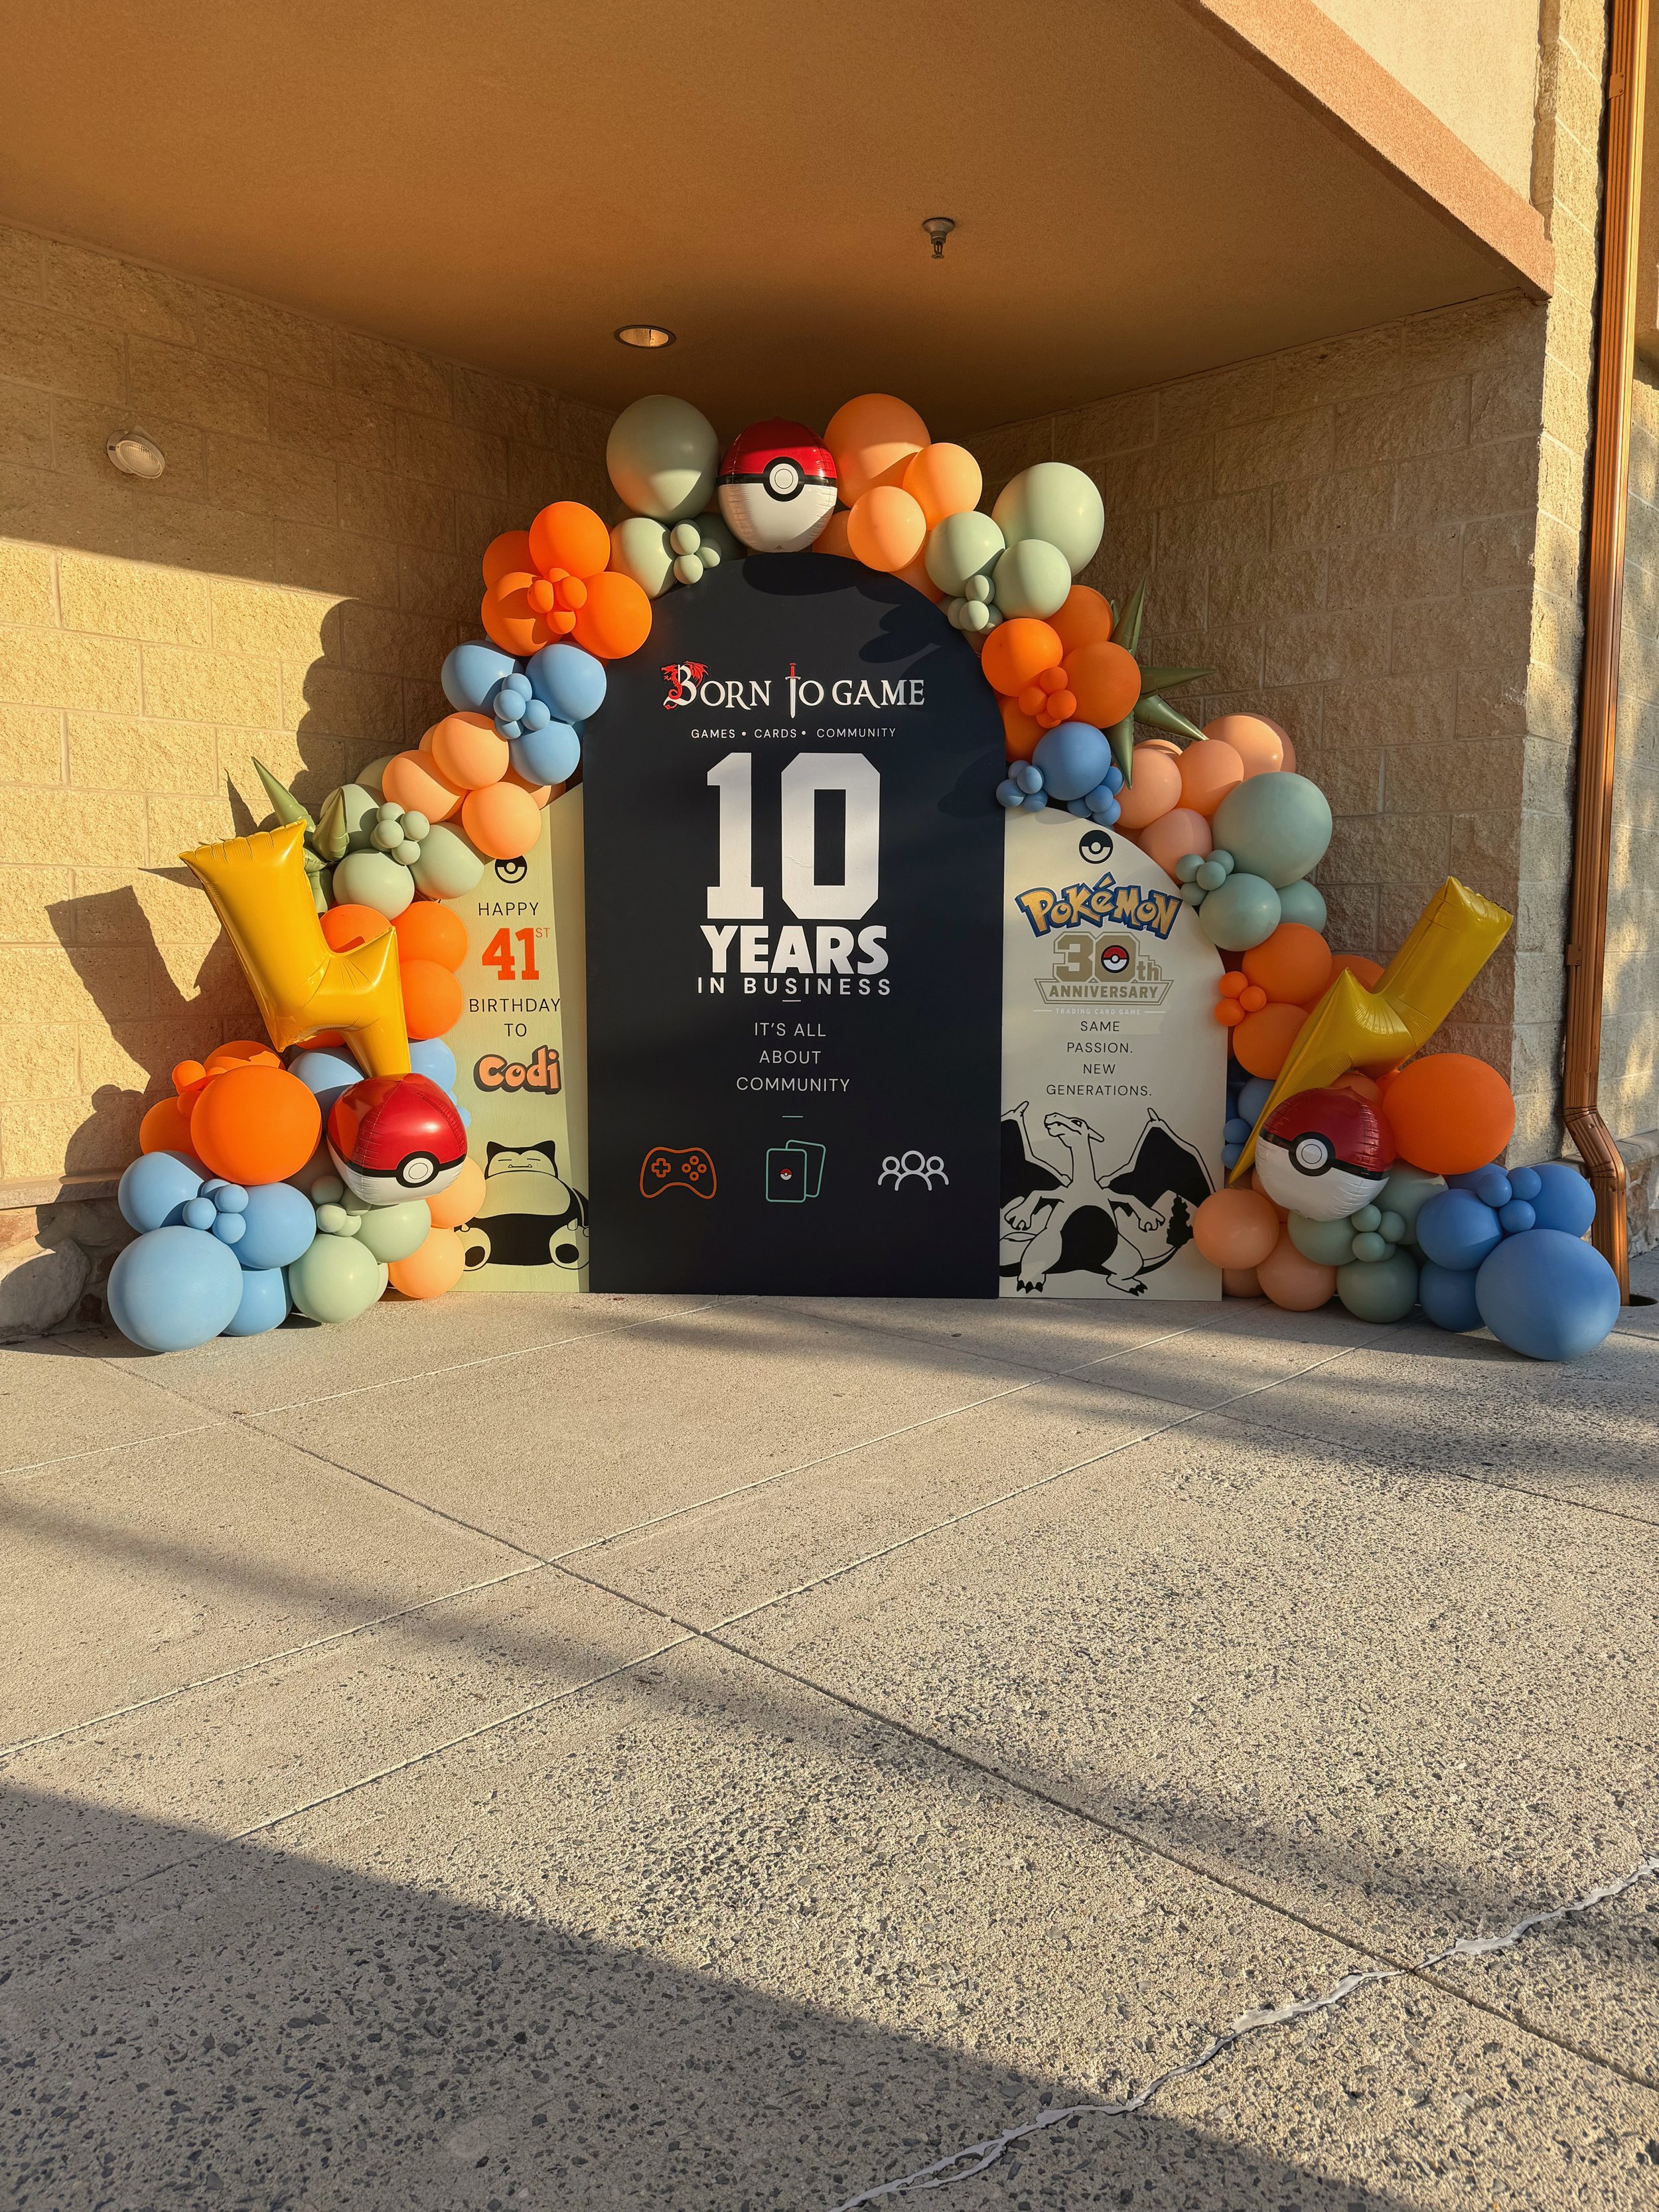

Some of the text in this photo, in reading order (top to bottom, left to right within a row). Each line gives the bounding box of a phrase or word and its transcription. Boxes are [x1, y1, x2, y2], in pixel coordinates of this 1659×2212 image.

[663, 664, 772, 710] BORN
[831, 679, 925, 709] GAME
[691, 727, 897, 739] GAMES CARDS COMMUNITY
[707, 752, 881, 920] 10
[478, 902, 539, 916] HAPPY
[699, 924, 889, 976] YEARS
[1054, 933, 1162, 983] 30th
[697, 977, 891, 995] IN BUSINESS
[1049, 985, 1159, 999] ANNIVERSARY
[469, 998, 561, 1013] BIRTHDAY
[504, 1023, 528, 1037] TO
[754, 1022, 826, 1037] IT'S ALL
[1080, 1021, 1120, 1032] SAME
[1066, 1042, 1133, 1053] PASSION.
[758, 1050, 822, 1064] ABOUT
[473, 1045, 562, 1095] Codi
[1083, 1063, 1116, 1074] NEW
[736, 1076, 851, 1092] COMMUNITY
[1046, 1084, 1153, 1096] GENERATIONS.
